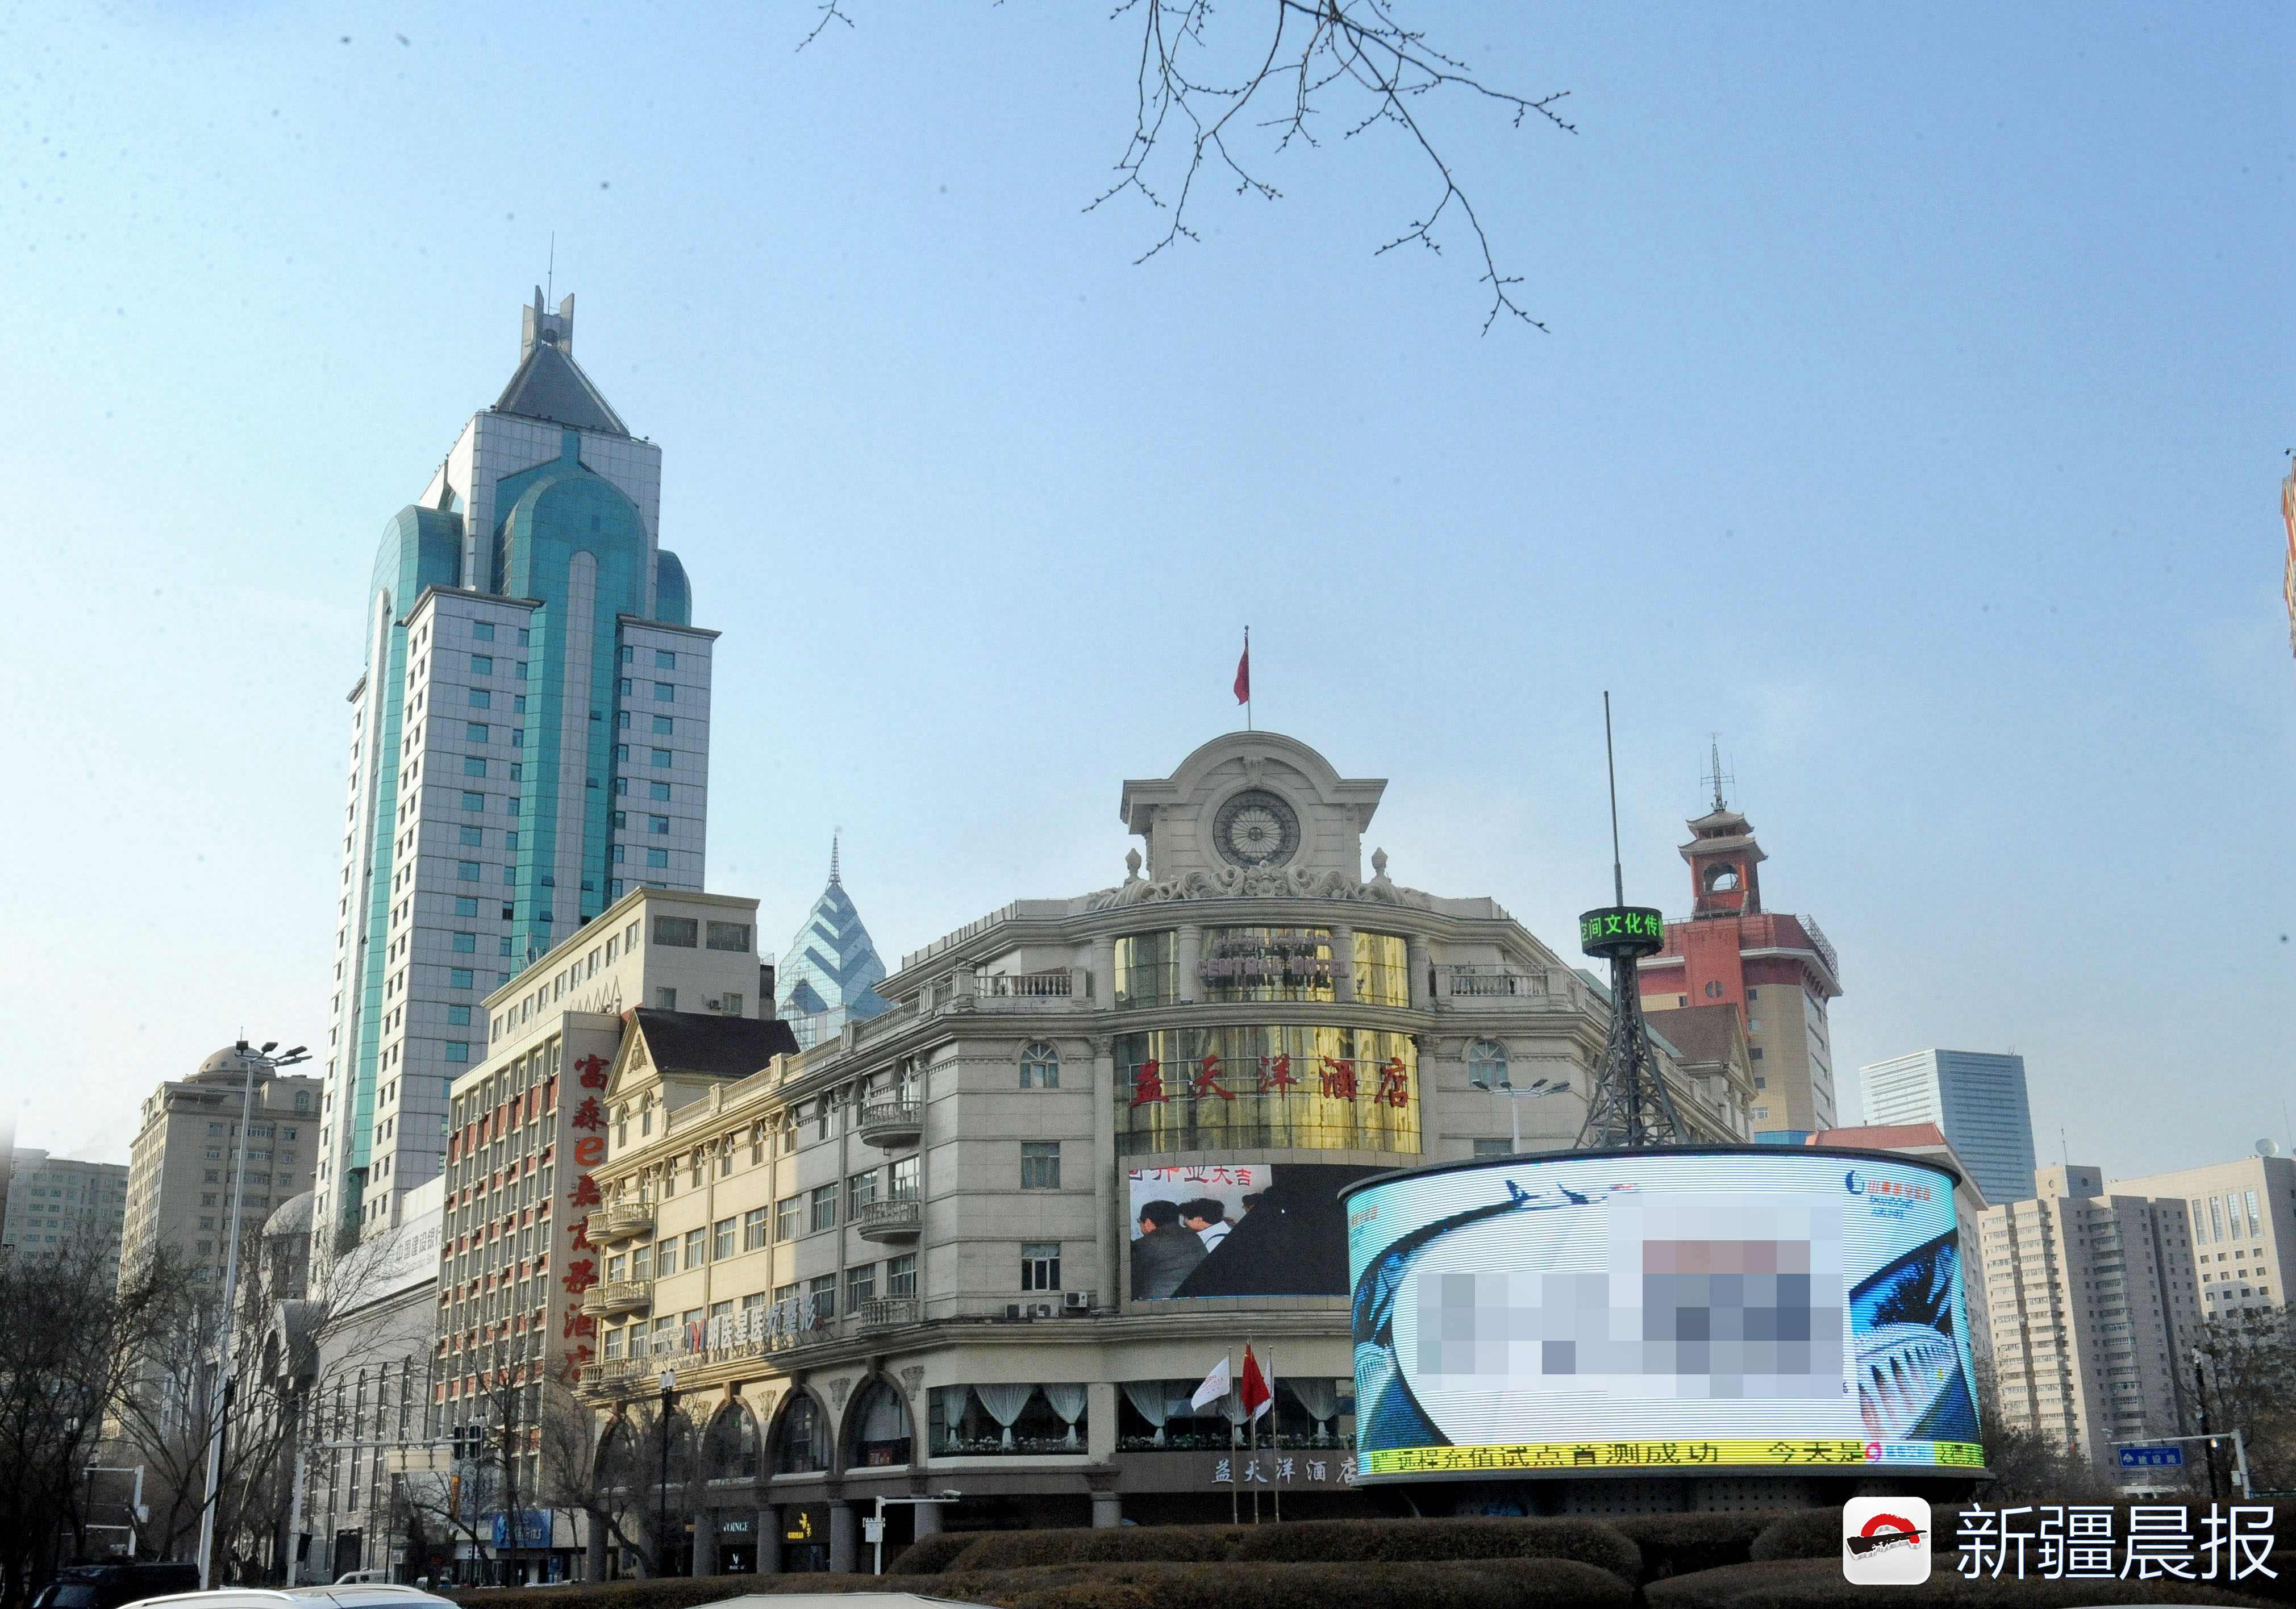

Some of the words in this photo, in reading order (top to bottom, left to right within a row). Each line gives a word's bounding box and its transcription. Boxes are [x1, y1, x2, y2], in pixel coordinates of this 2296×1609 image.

[1291, 955, 1349, 978] HOTEL
[1130, 1053, 1408, 1108] 益天洋酒店
[1768, 1441, 1864, 1464] 今天是
[1211, 1456, 1359, 1485] 益天洋酒店
